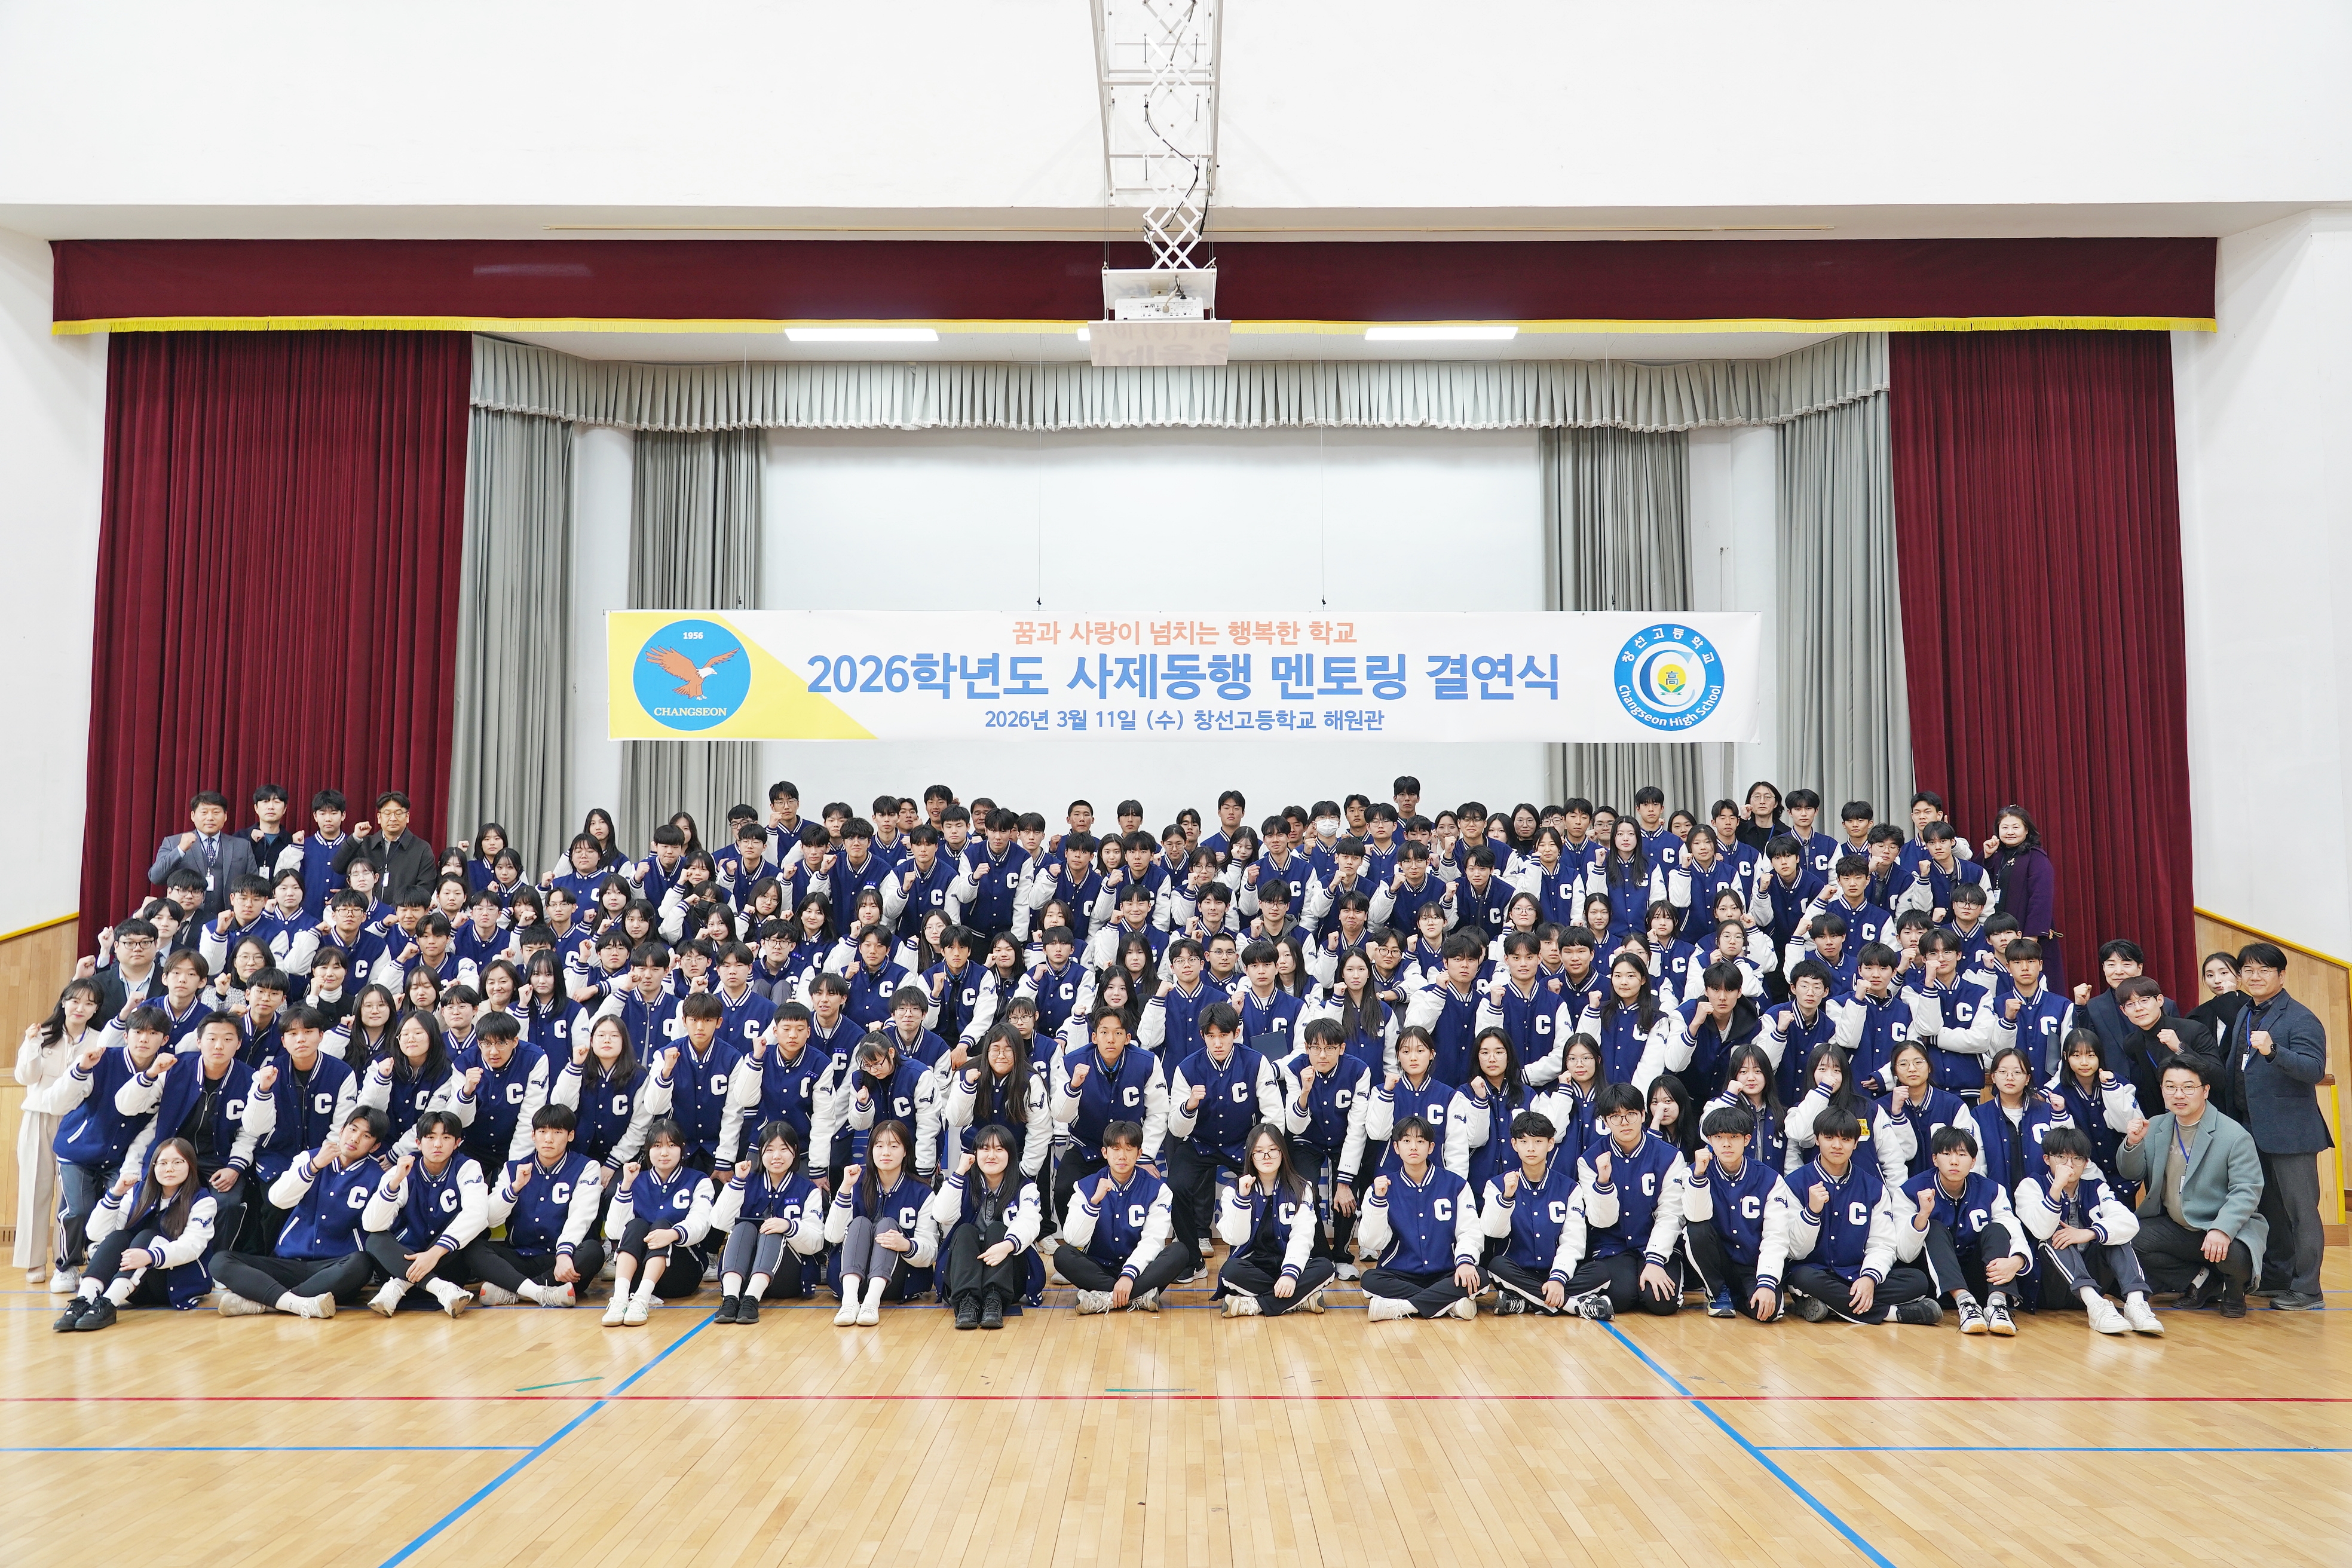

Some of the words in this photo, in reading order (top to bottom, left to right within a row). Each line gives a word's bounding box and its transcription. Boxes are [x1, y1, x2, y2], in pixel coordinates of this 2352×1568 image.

[1012, 621, 1061, 645] 꿈과
[1070, 621, 1140, 645] 사랑이
[1150, 621, 1220, 645] 넘치는
[1228, 621, 1301, 645] 행복한
[1309, 621, 1357, 645] 학교
[1622, 627, 1714, 664] 창선고등학교
[807, 653, 1049, 700] 2026학년도
[1067, 653, 1251, 700] 사제동행
[1272, 653, 1407, 700] 멘토링
[1426, 653, 1558, 700] 결연식
[1665, 670, 1679, 685] 高
[654, 708, 727, 716] CHANGSEON
[1619, 685, 1667, 726] Changseon
[1670, 713, 1699, 727] High
[1695, 685, 1722, 716] School
[985, 709, 1049, 731] 2026년
[1056, 709, 1087, 731] 3월
[1096, 710, 1136, 731] 11일
[1147, 710, 1183, 731] (수)
[1194, 710, 1316, 731] 창선고등학교
[1324, 710, 1385, 731] 해원관
[1663, 848, 1674, 863] C
[1815, 855, 1827, 870] C
[1739, 861, 1751, 876] C
[1007, 872, 1018, 889] C
[1290, 881, 1301, 896] C
[931, 889, 943, 905] C
[1560, 884, 1572, 899] C
[1083, 901, 1094, 916] C
[1490, 908, 1501, 923] C
[1862, 923, 1876, 941] C
[355, 960, 368, 978] C
[565, 951, 581, 968] C
[813, 952, 823, 968] C
[1672, 957, 1686, 973] C
[879, 981, 893, 997] C
[963, 988, 975, 1006] C
[1059, 983, 1073, 1000] C
[1226, 982, 1237, 995] C
[1956, 1002, 1973, 1021] C
[555, 1020, 566, 1038] C
[744, 1019, 760, 1039] C
[1273, 1018, 1287, 1033] C
[1536, 1015, 1551, 1034] C
[1892, 1022, 1906, 1042] C
[2040, 1016, 2057, 1035] C
[832, 1053, 847, 1071] C
[506, 1083, 523, 1104] C
[711, 1074, 727, 1095] C
[1232, 1082, 1248, 1102] C
[315, 1094, 332, 1113] C
[415, 1091, 430, 1110] C
[612, 1095, 627, 1115] C
[1123, 1086, 1139, 1107] C
[1336, 1089, 1351, 1108] C
[226, 1099, 244, 1120] C
[893, 1097, 911, 1117] C
[1428, 1104, 1444, 1125] C
[552, 1183, 569, 1204] C
[1642, 1173, 1655, 1196] C
[347, 1186, 368, 1209] C
[440, 1189, 457, 1212] C
[673, 1189, 690, 1209] C
[1743, 1196, 1760, 1218] C
[899, 1207, 915, 1229] C
[1003, 1205, 1018, 1227] C
[1129, 1205, 1145, 1227] C
[1278, 1202, 1296, 1225] C
[1434, 1199, 1451, 1221] C
[1548, 1201, 1566, 1223] C
[1849, 1202, 1867, 1225] C
[1969, 1209, 1988, 1232] C
